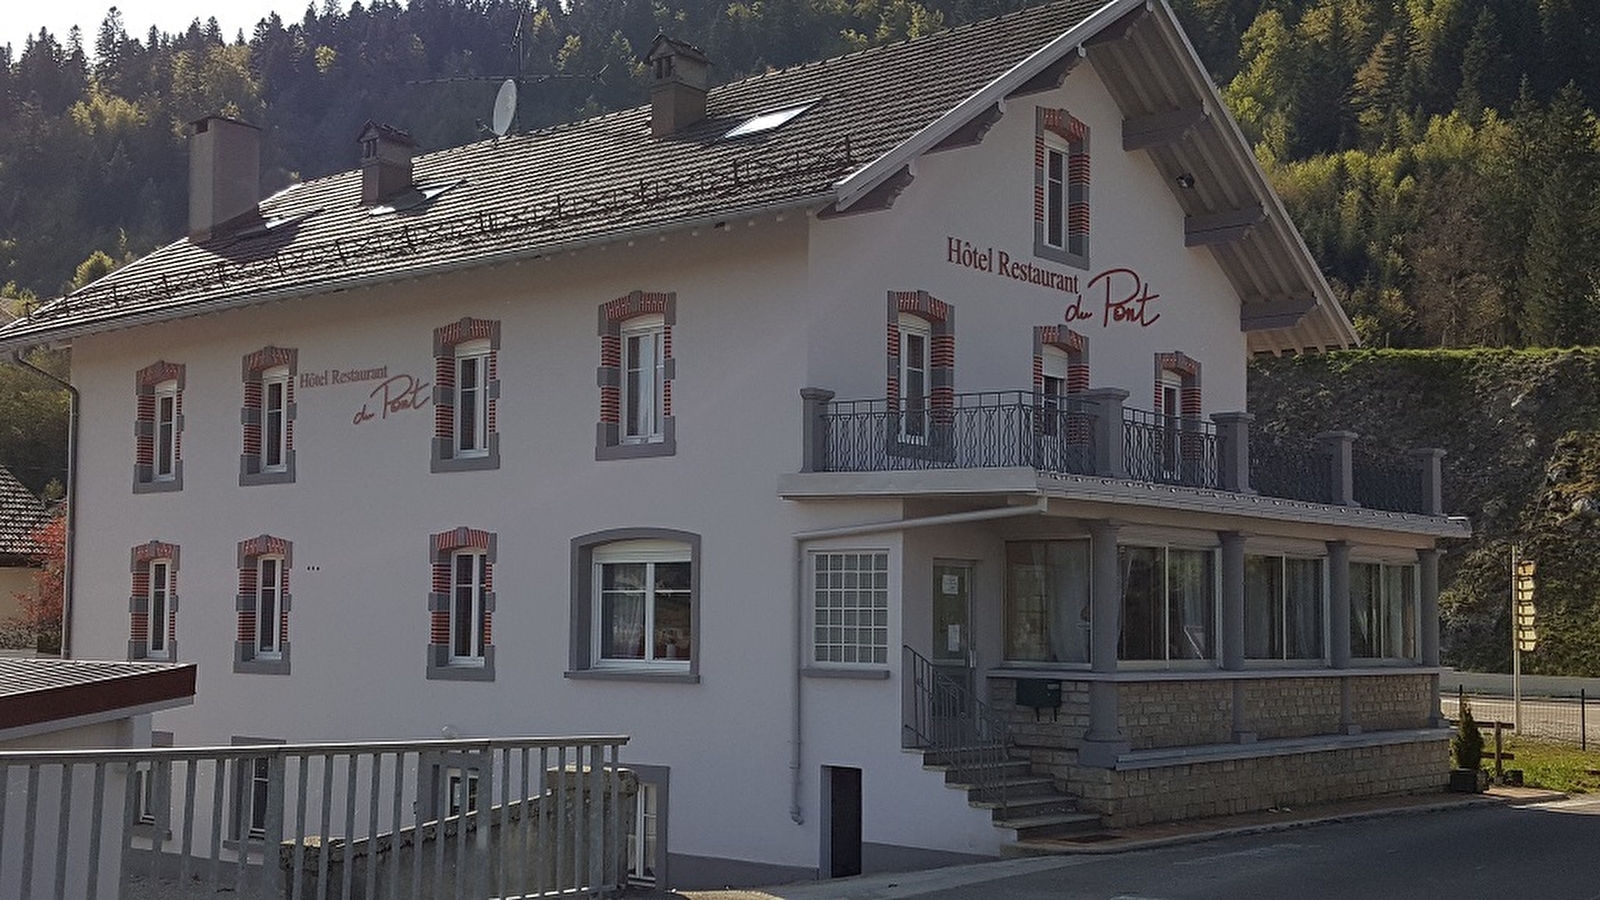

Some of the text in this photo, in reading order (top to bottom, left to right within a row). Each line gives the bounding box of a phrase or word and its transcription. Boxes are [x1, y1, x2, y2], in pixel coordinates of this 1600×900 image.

[947, 236, 1080, 294] Hôtel Restaurant
[1065, 268, 1160, 327] du Pont
[299, 365, 388, 389] Hôtel Restaurant
[353, 374, 430, 425] du Pont
